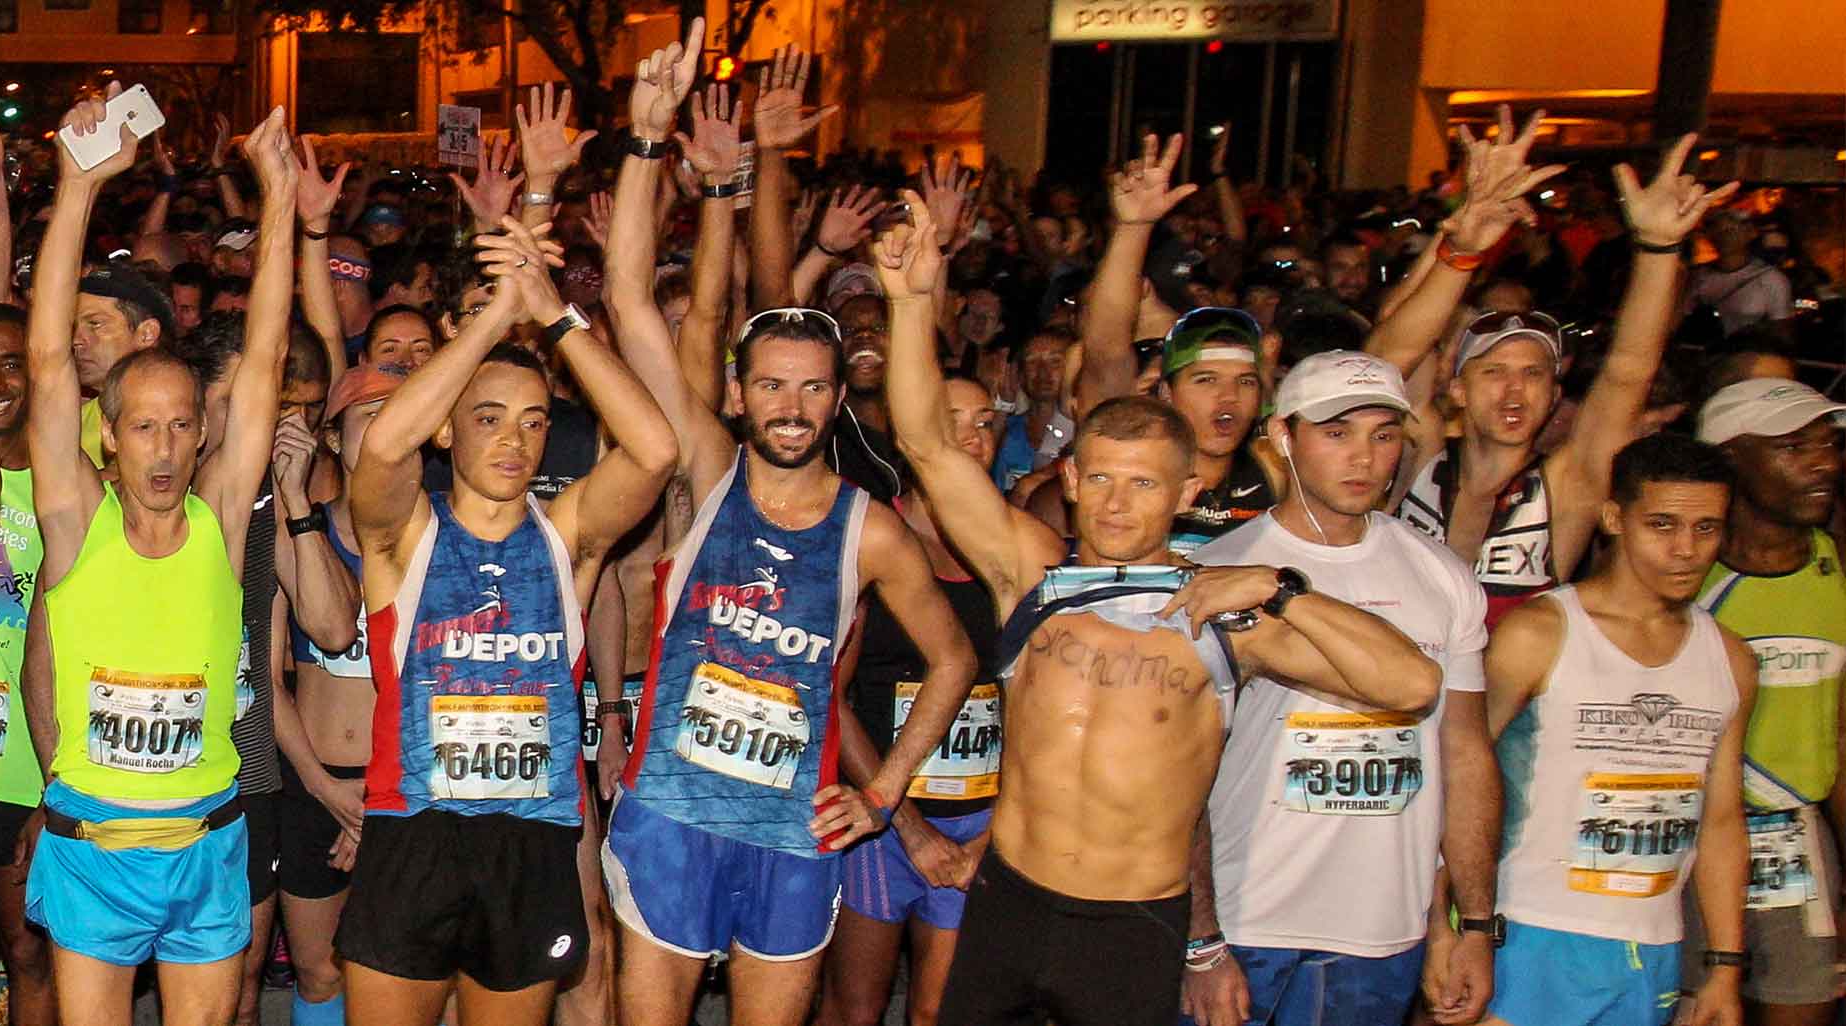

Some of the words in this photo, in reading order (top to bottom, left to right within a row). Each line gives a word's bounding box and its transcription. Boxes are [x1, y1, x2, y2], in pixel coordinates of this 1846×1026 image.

[1075, 6, 1187, 31] parking
[443, 631, 564, 662] DEPOT
[709, 595, 832, 663] DEPOT
[103, 713, 185, 755] 4007
[695, 713, 783, 767] 5910
[110, 752, 144, 768] Manuel
[146, 757, 175, 768] Rocha
[446, 742, 540, 781] 6466
[1307, 758, 1405, 797] 3907
[1325, 799, 1390, 810] HYPERBARIC
